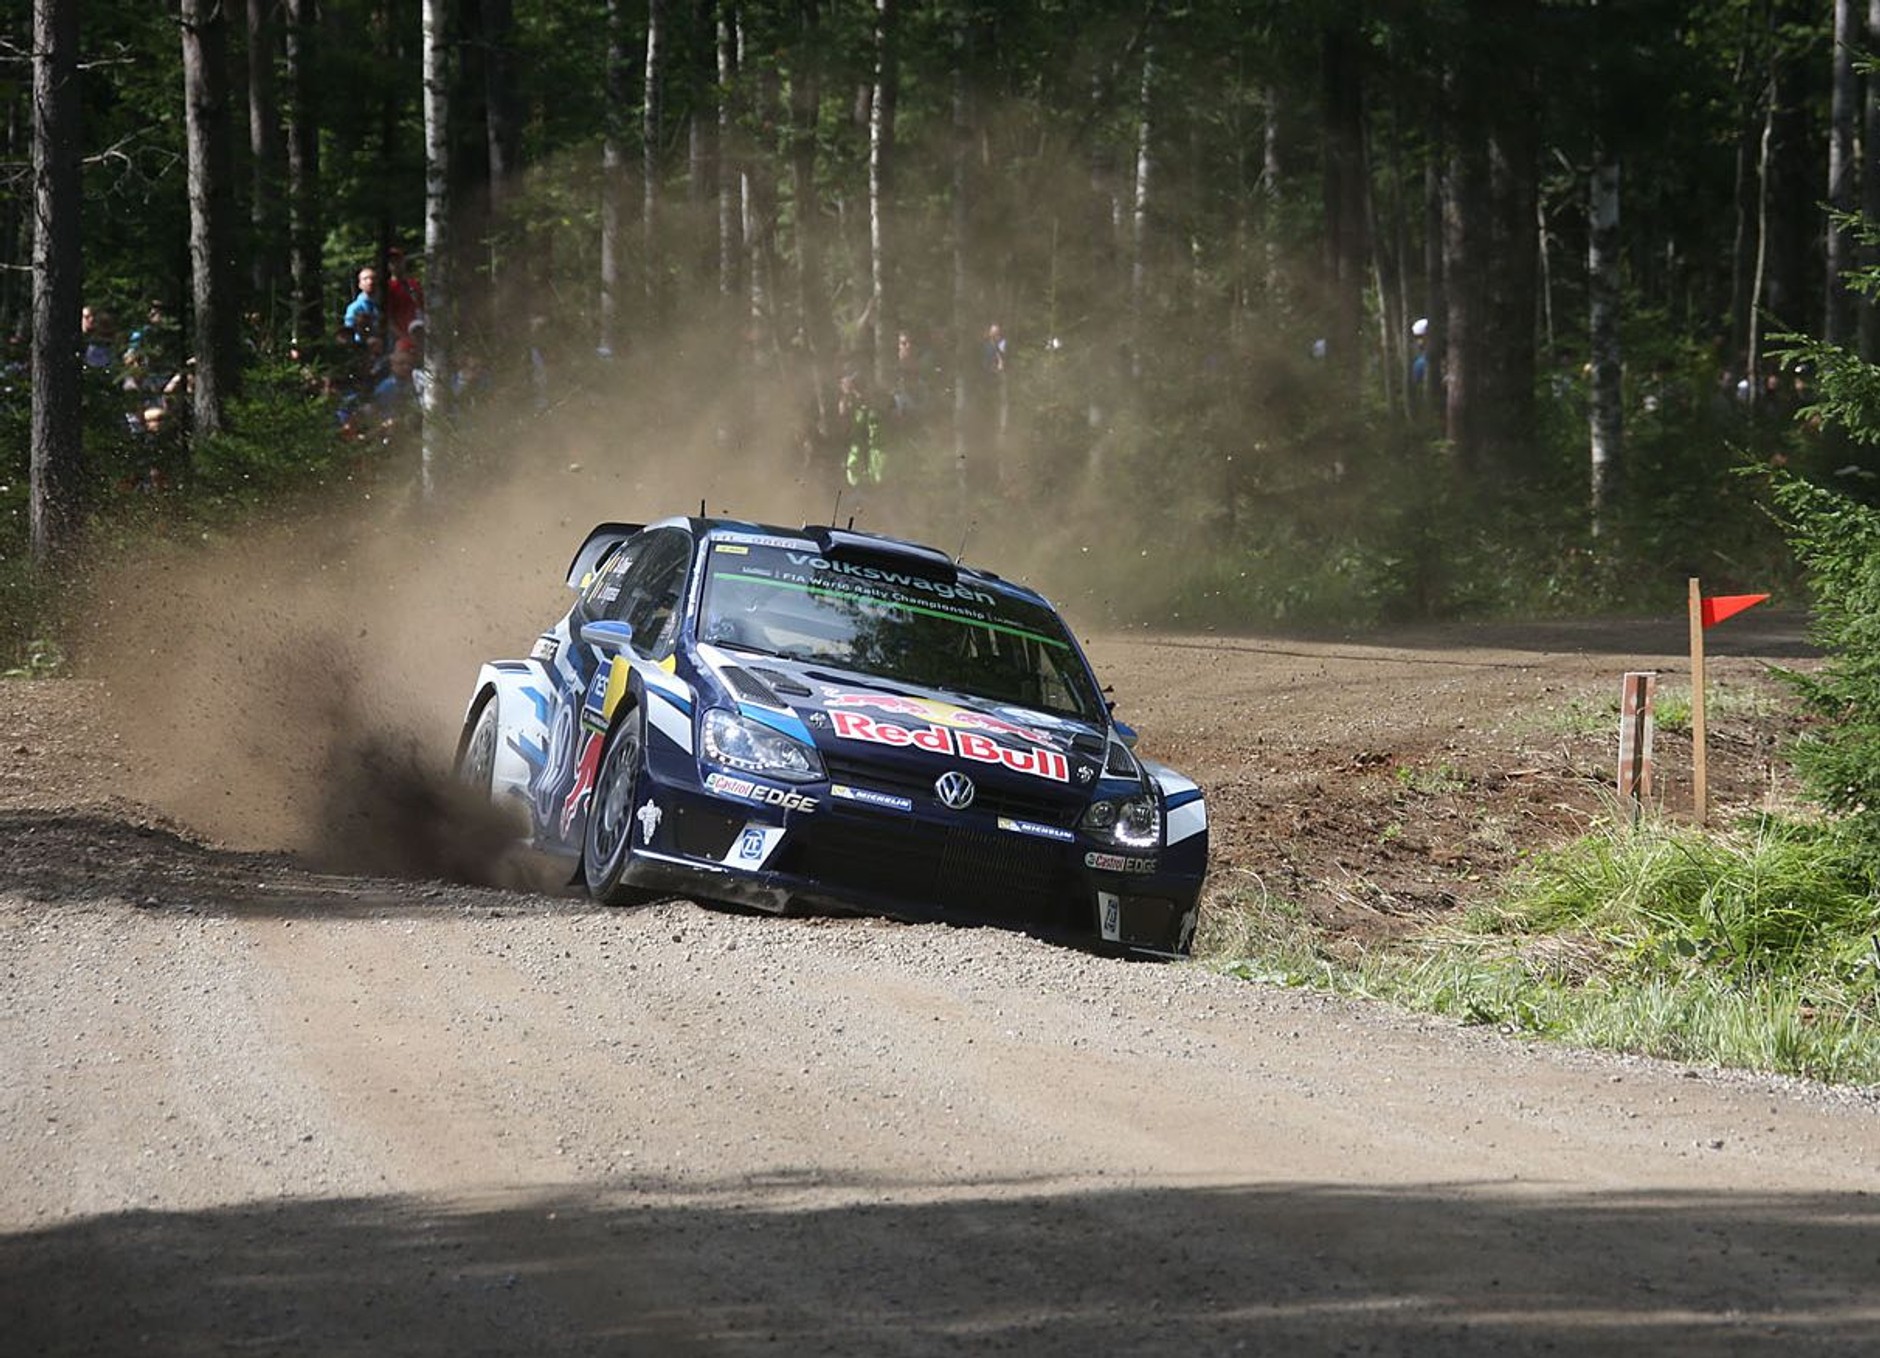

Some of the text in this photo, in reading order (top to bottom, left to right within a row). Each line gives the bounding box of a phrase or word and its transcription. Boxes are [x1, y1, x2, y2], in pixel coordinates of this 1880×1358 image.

[783, 572, 985, 620] FIA World Rally Championship
[787, 552, 995, 605] Volkswagen
[829, 711, 1070, 782] Red Bull
[715, 776, 820, 812] Castrol EDGE
[855, 791, 909, 808] MICHELIN
